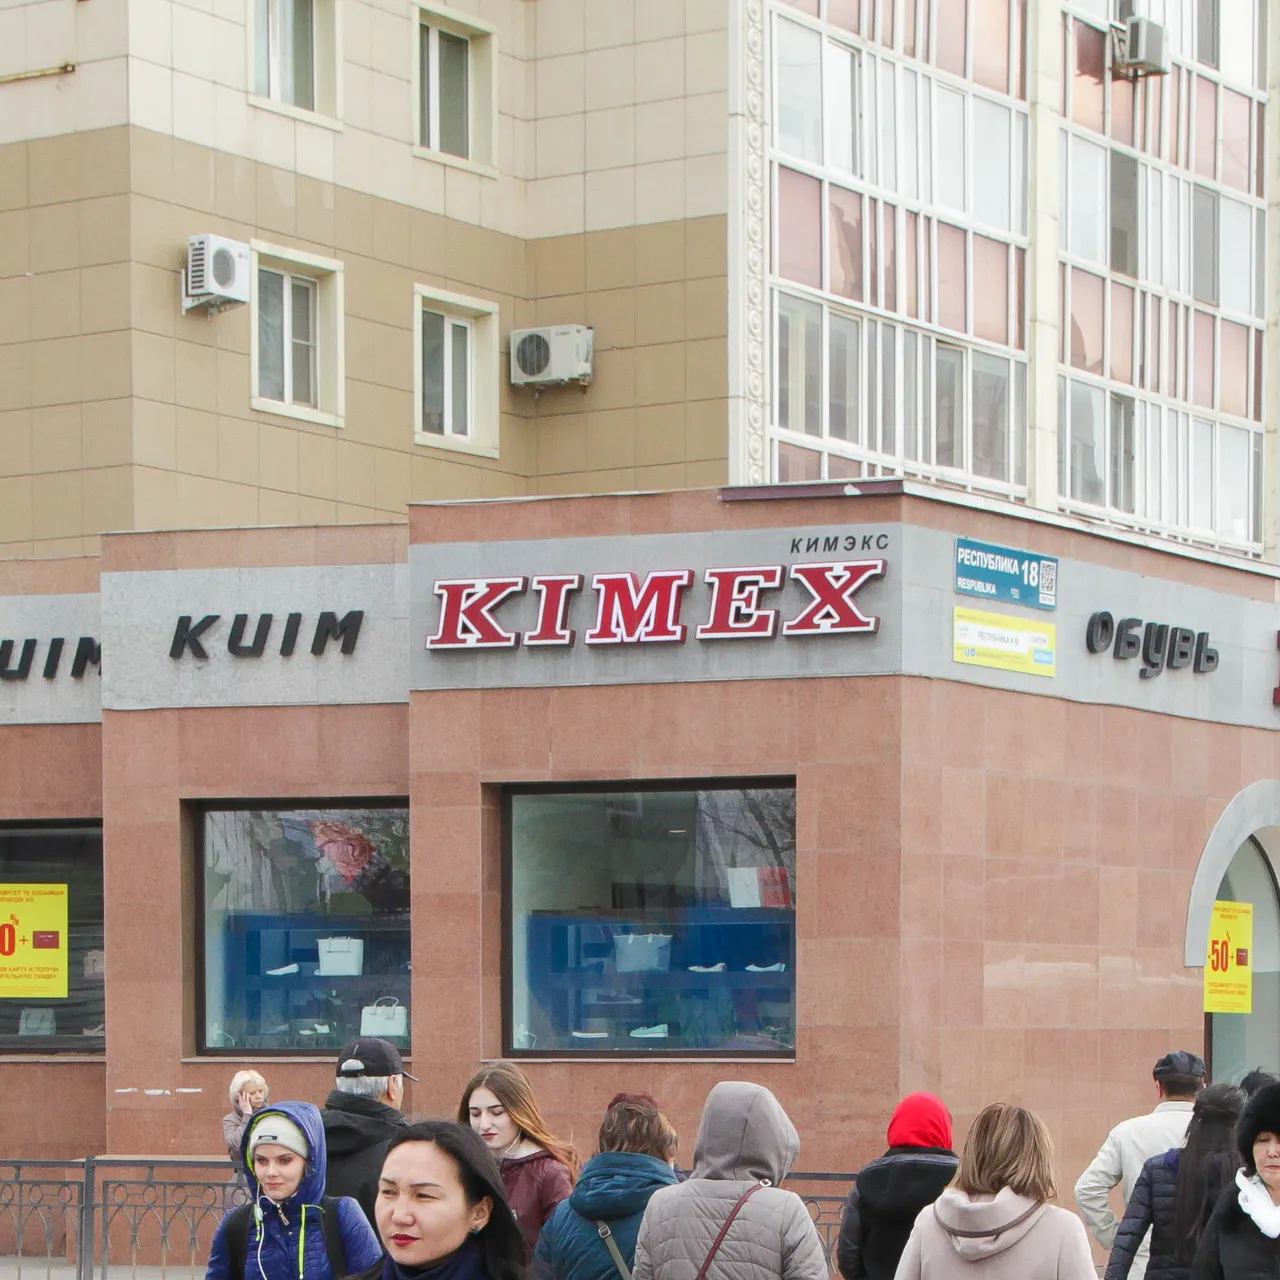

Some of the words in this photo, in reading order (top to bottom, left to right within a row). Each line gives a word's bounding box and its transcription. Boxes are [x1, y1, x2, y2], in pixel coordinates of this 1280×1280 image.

[790, 533, 889, 554] КИМЭКС
[957, 547, 1019, 576] РЕСПУБЛИКА
[1021, 559, 1039, 587] 18
[957, 577, 997, 595] RESPUBLIKA
[424, 558, 888, 652] KIMEX
